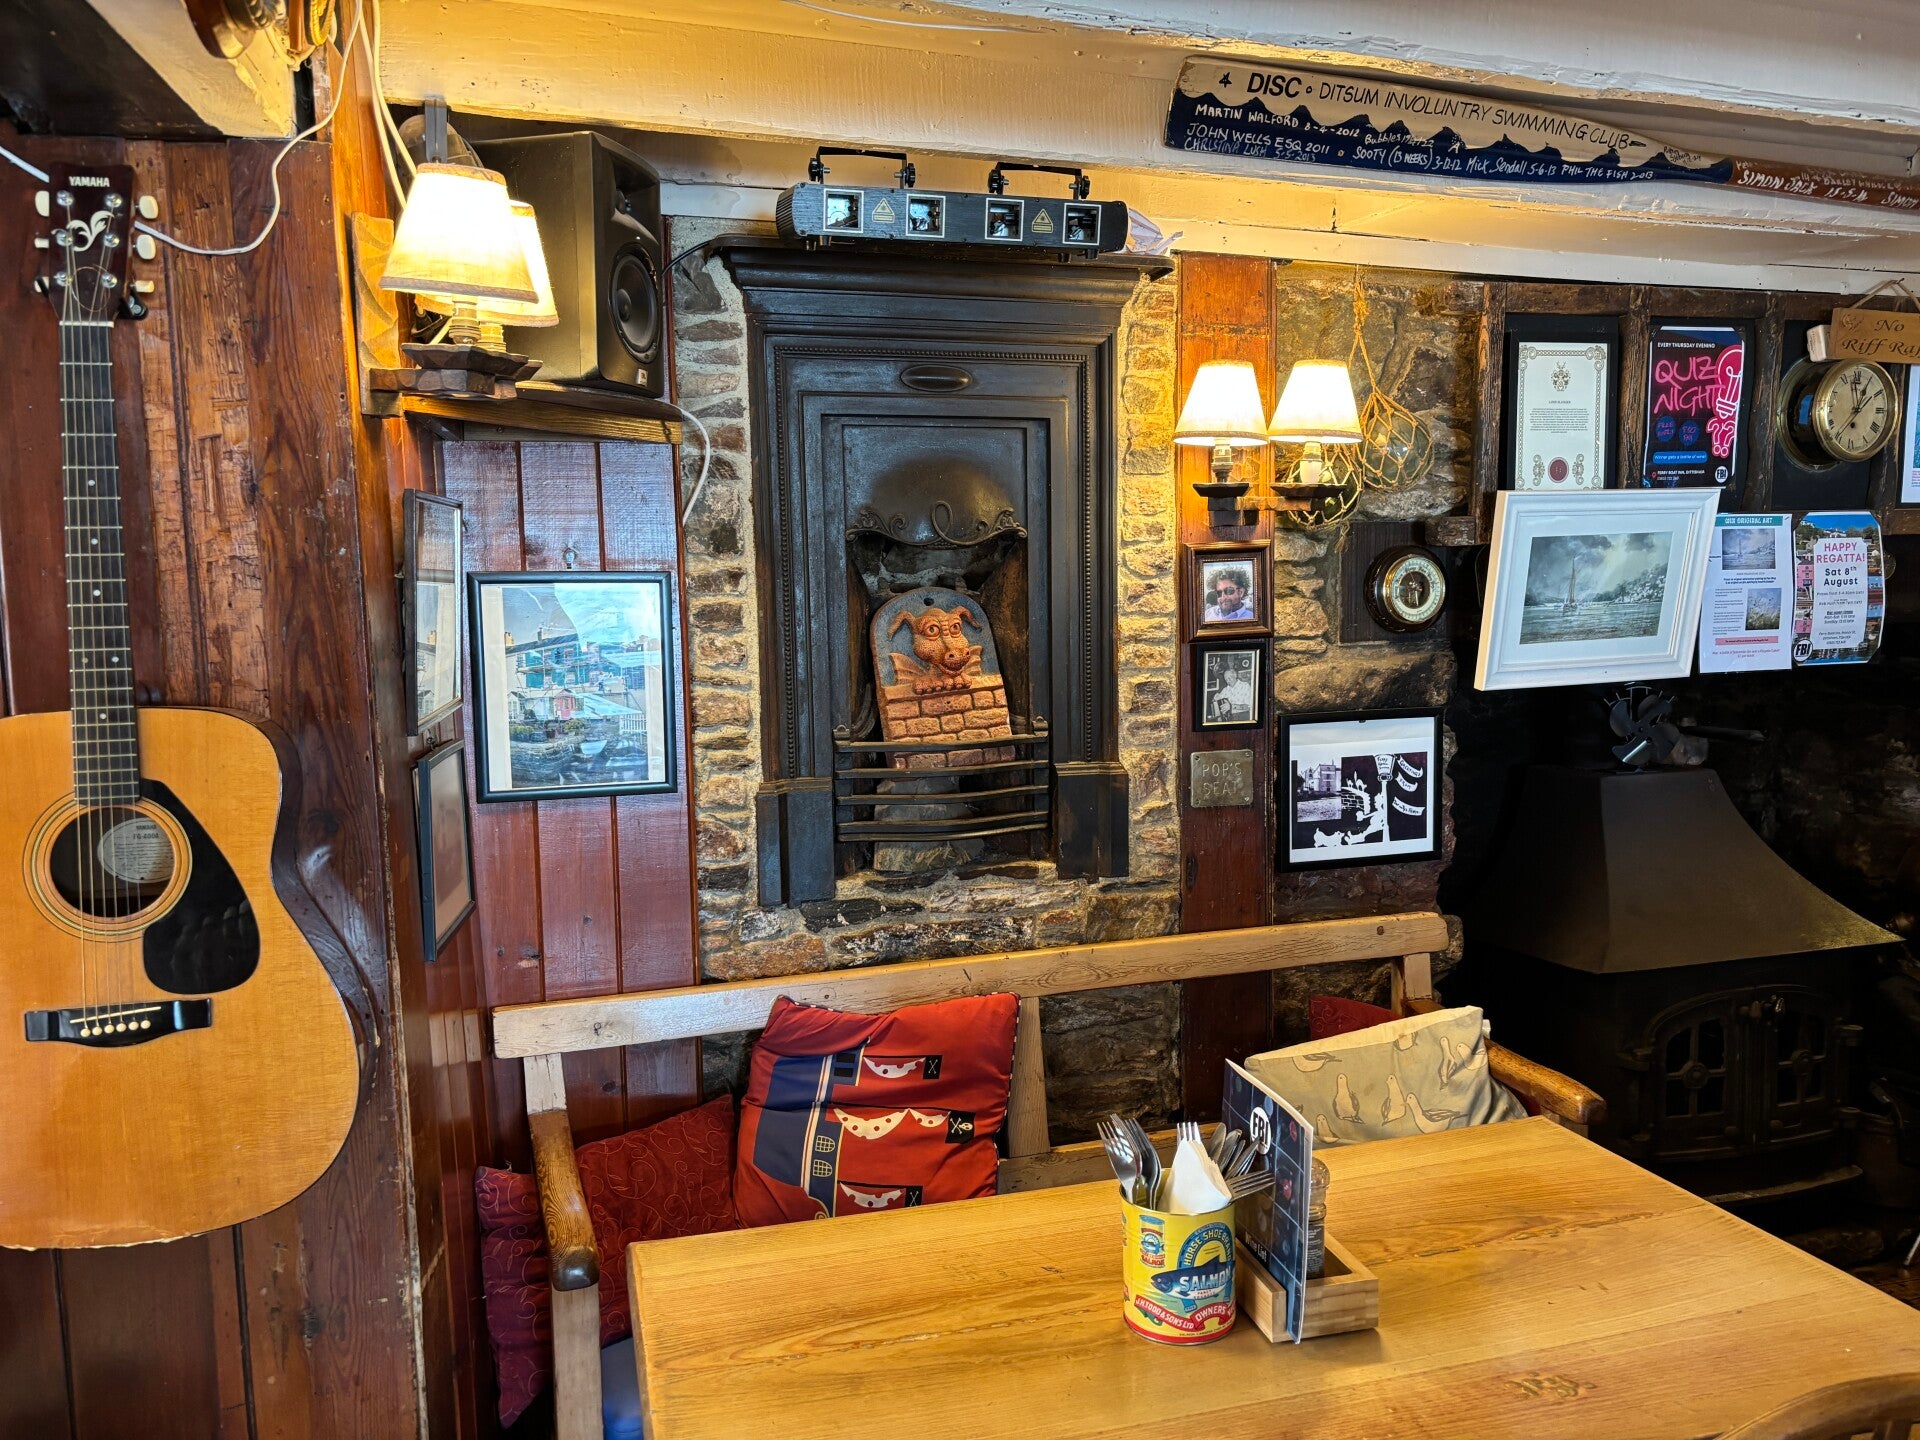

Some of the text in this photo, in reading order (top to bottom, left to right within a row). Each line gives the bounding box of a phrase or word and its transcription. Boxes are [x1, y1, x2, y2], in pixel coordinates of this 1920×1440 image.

[1195, 104, 1243, 120] MARTIN
[1248, 111, 1299, 128] WALFORD
[1247, 73, 1630, 149] DISC DITSUM INVOLUNTRY SWIMMING CLUB
[1186, 122, 1330, 154] JOHN WELLS ESQ 2011
[1352, 145, 1387, 164] SOOTY
[1585, 166, 1604, 178] THE
[1606, 168, 1629, 179] FISH
[1737, 169, 1785, 190] SIMON
[68, 176, 111, 188] YAMAHA
[1873, 319, 1905, 332] No
[1842, 338, 1920, 358] Riff Raf
[1655, 356, 1719, 389] QUIZ
[1653, 384, 1726, 417] NIGHT
[1824, 542, 1858, 552] HAPPY
[1816, 553, 1866, 563] REGATTA!
[1825, 568, 1841, 576] Sat
[1823, 577, 1859, 588] August
[1795, 644, 1811, 656] FBI
[1202, 762, 1242, 777] POP'S
[1203, 780, 1238, 796] SEAT
[1253, 1111, 1269, 1145] FBI
[1183, 1236, 1203, 1266] HORSE
[1202, 1229, 1223, 1240] SHOE
[1180, 1265, 1231, 1292] SALMON
[1195, 1305, 1227, 1322] OWNERS
